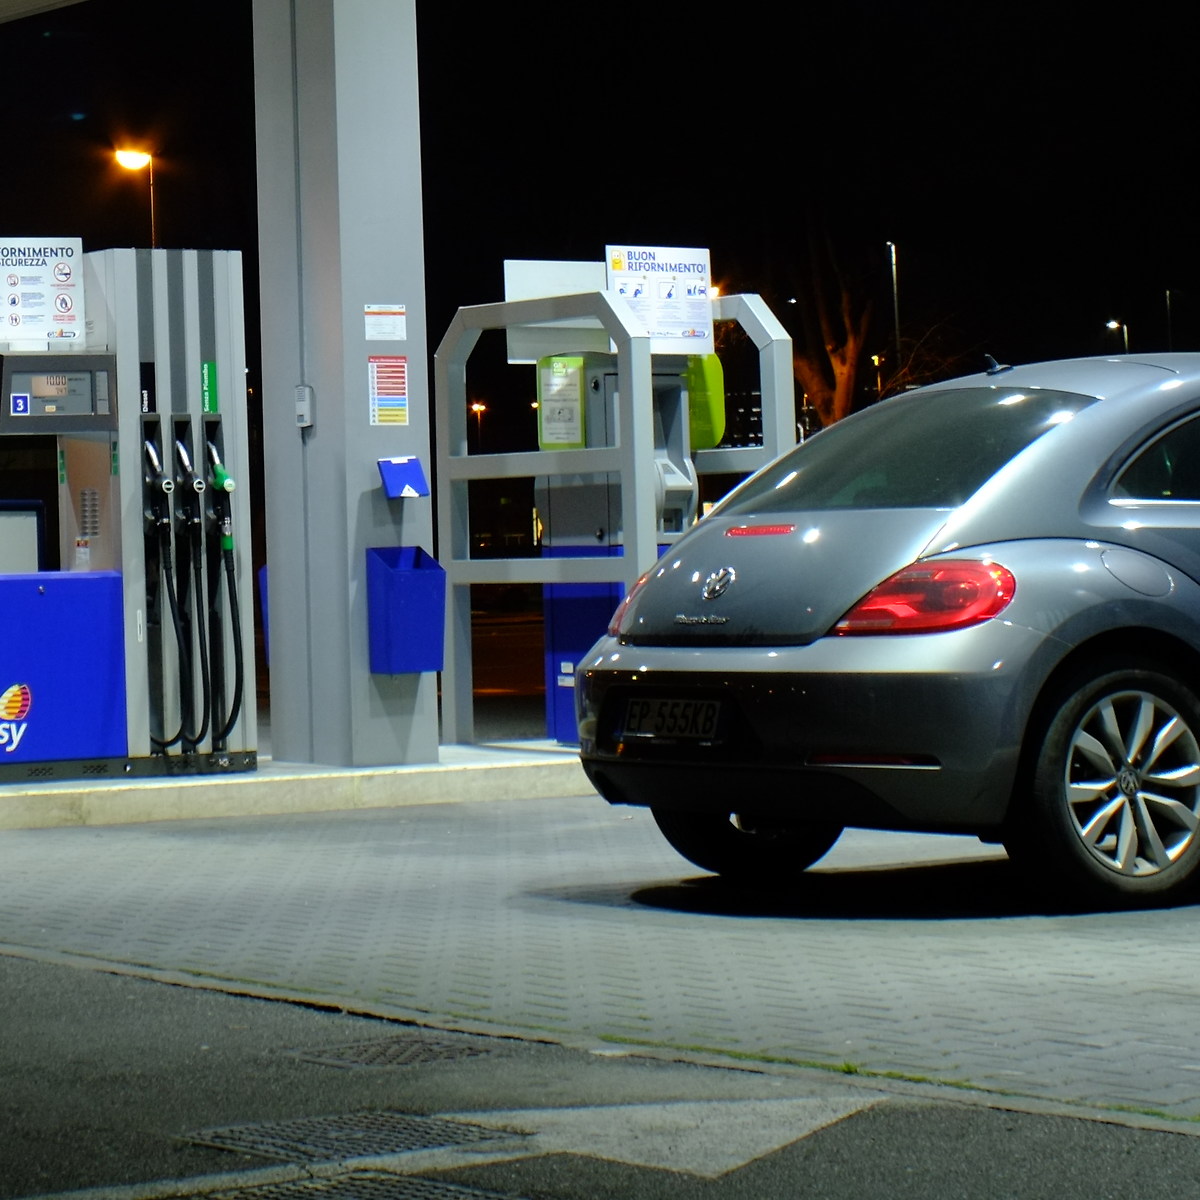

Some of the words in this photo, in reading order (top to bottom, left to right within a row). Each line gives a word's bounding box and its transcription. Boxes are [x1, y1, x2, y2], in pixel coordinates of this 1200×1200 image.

[627, 250, 656, 261] BUON
[627, 261, 707, 274] RIFORNIMENTO!
[16, 399, 24, 411] 3
[626, 700, 650, 732] EP
[655, 701, 717, 735] 555KB
